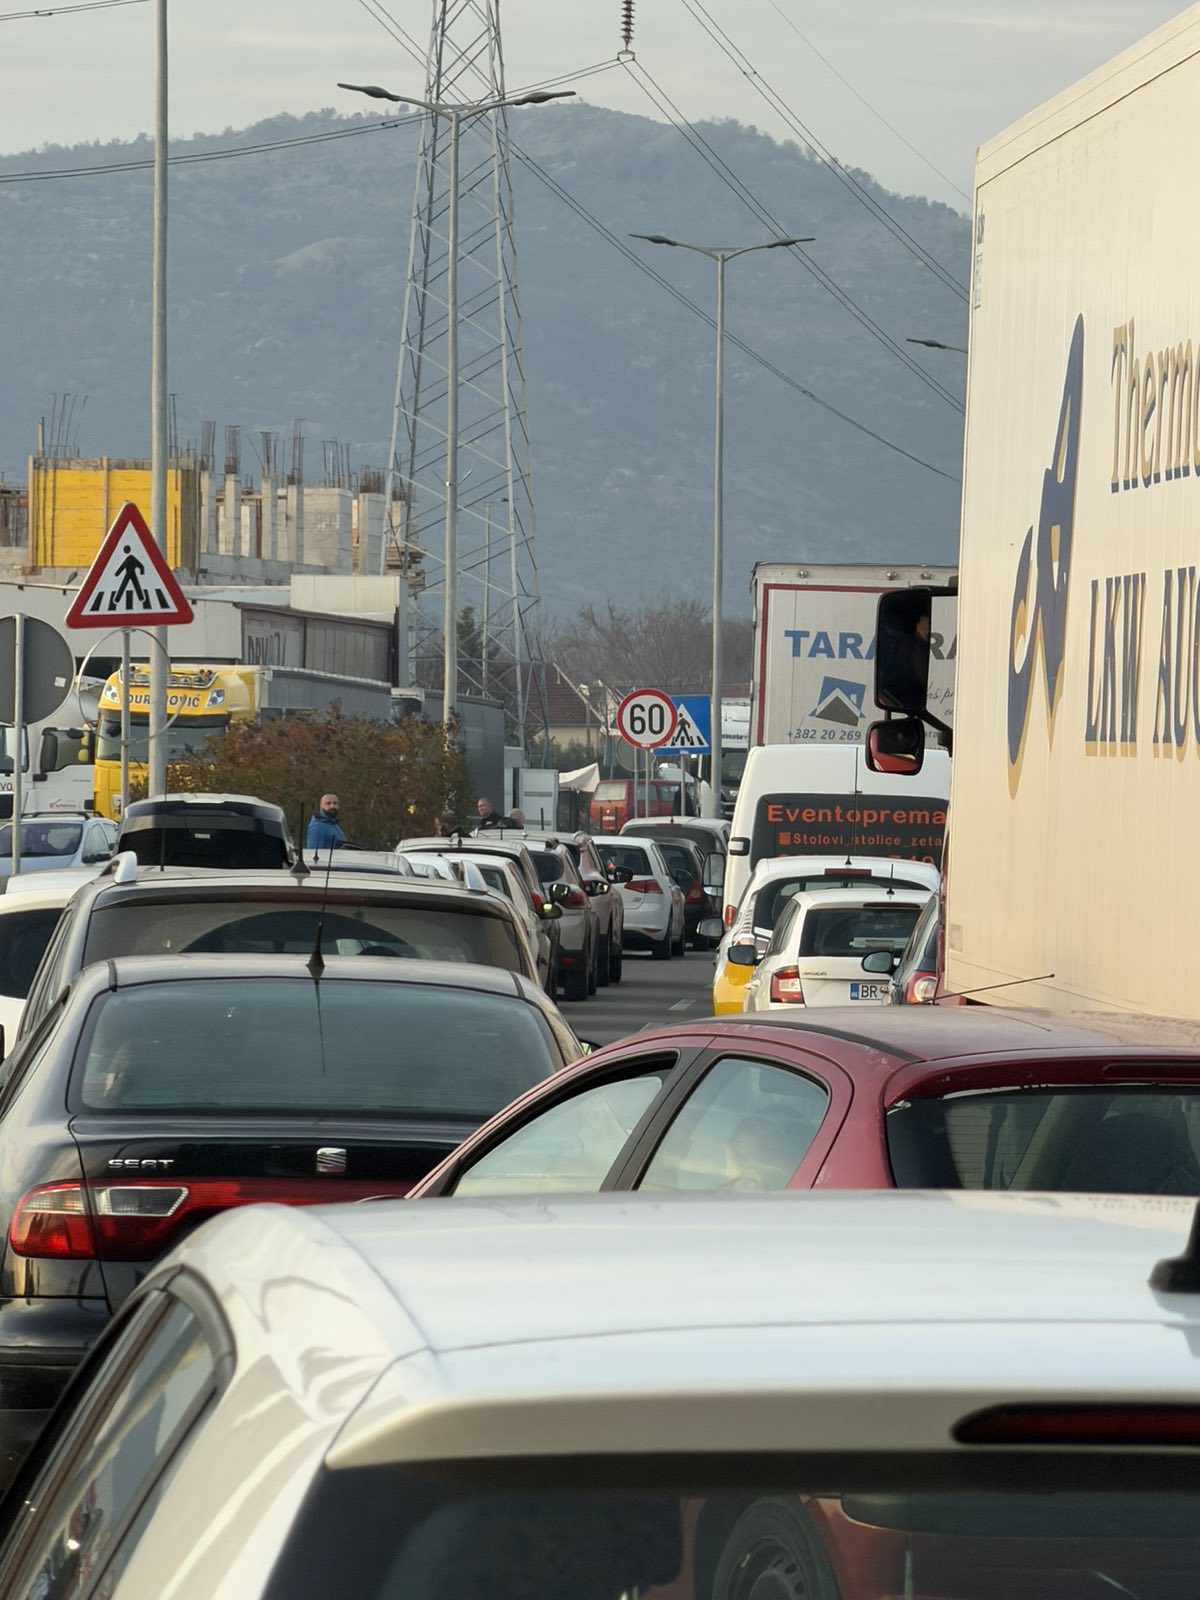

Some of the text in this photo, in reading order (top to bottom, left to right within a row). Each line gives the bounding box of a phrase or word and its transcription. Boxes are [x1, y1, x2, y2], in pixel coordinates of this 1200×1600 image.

[1085, 572, 1148, 757] LKW
[629, 703, 665, 735] 60
[786, 728, 862, 741] +382 20 269
[861, 985, 878, 998] BR
[108, 1159, 175, 1169] SEAT
